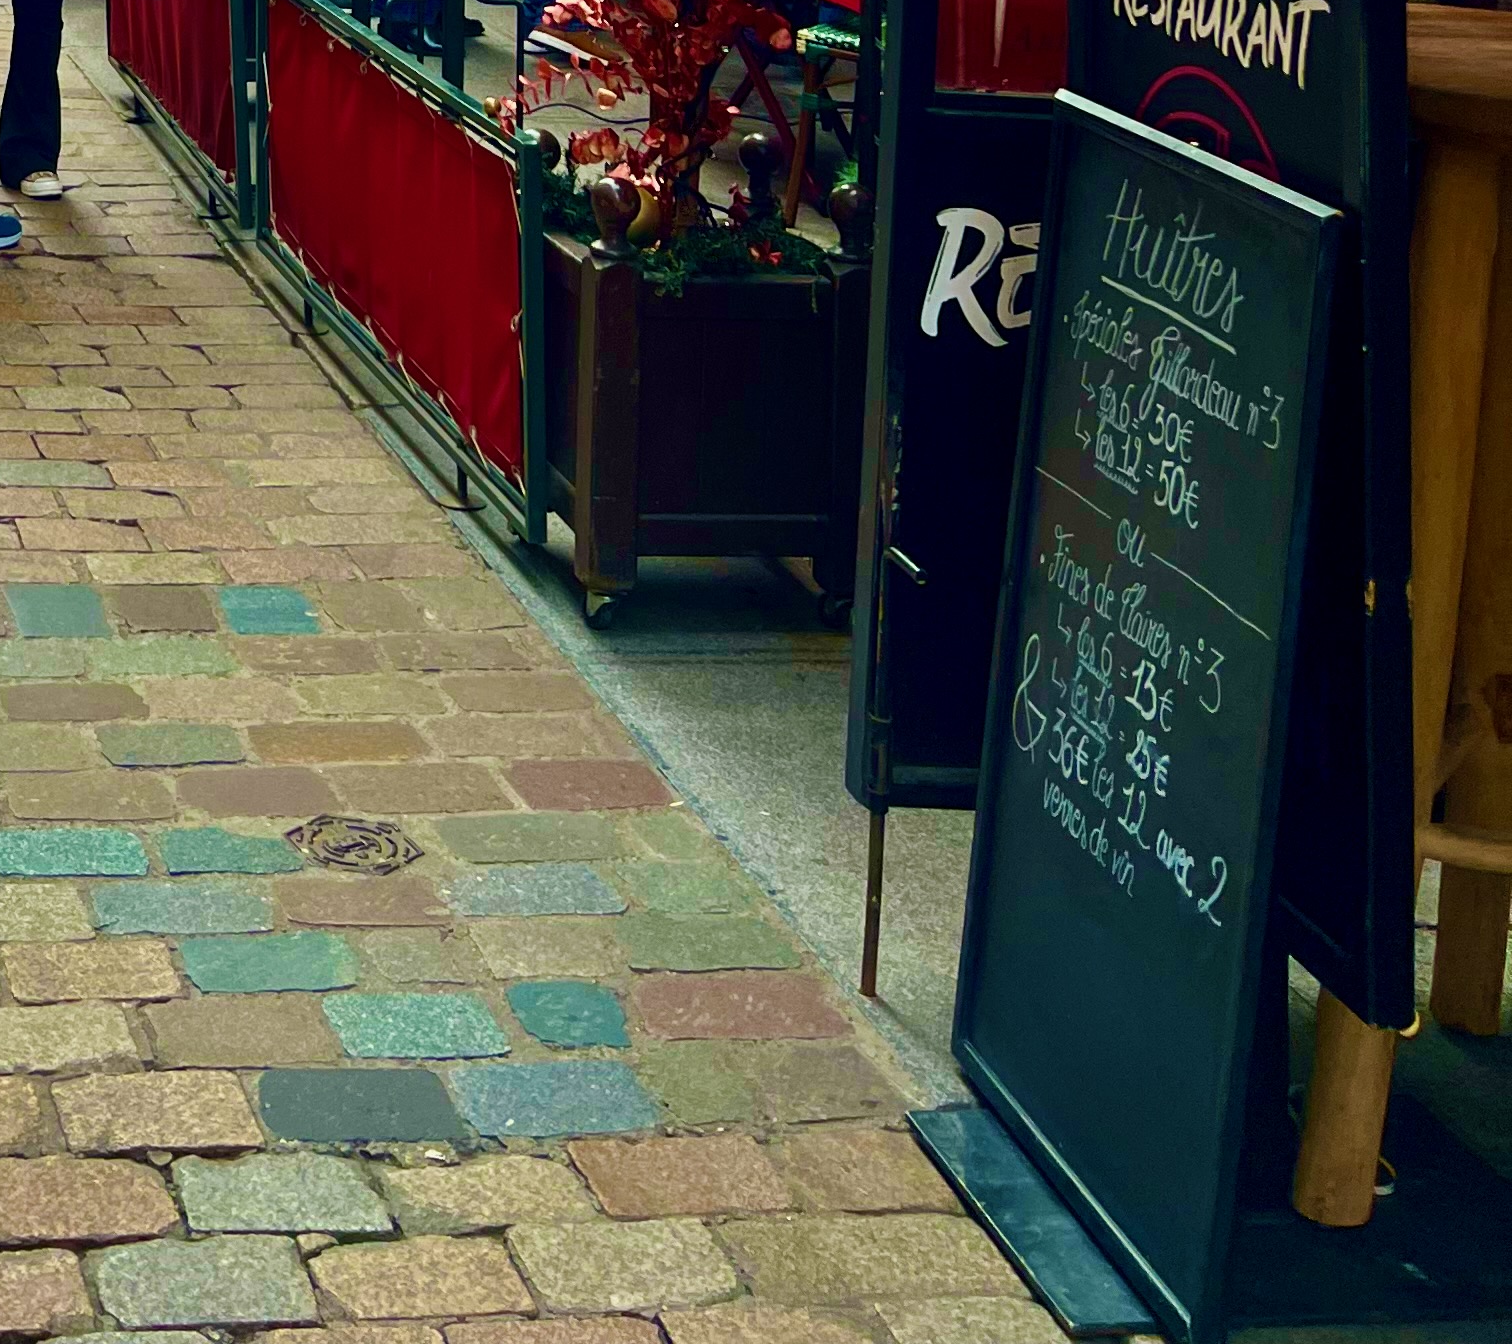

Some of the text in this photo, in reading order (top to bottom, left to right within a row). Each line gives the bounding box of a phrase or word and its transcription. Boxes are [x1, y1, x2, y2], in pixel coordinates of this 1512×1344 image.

[1102, 178, 1244, 334] Huîtres
[1098, 368, 1117, 419] les
[1147, 403, 1196, 464] 30€
[1115, 433, 1142, 483] 12
[1153, 459, 1200, 530] 50€
[1047, 523, 1091, 606] Fines
[1094, 563, 1116, 622] de
[1042, 777, 1136, 898] verres de vin
[1048, 707, 1089, 786] 36€
[1117, 782, 1151, 851] 12
[1155, 828, 1196, 898] avec
[1197, 855, 1229, 927] 2
